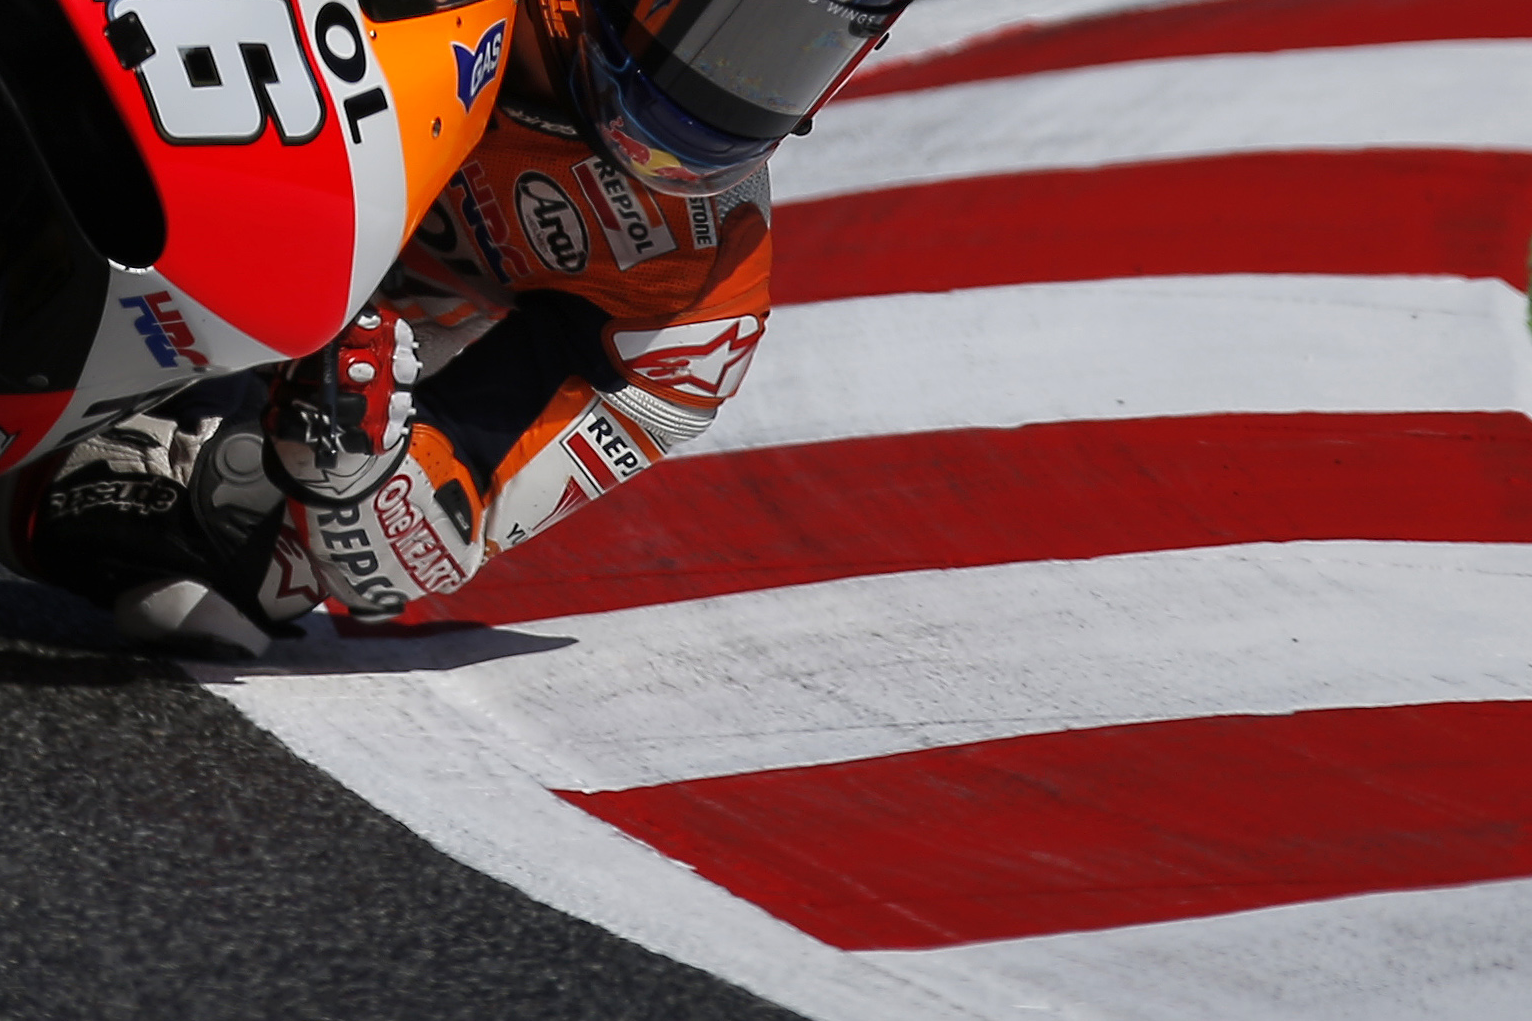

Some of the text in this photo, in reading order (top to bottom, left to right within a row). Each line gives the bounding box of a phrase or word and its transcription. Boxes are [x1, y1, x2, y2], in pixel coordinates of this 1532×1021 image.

[826, 2, 875, 25] WINGS
[471, 32, 502, 97] GAS
[519, 181, 588, 271] Arai
[593, 160, 655, 255] REPSOL
[120, 290, 210, 369] HRC
